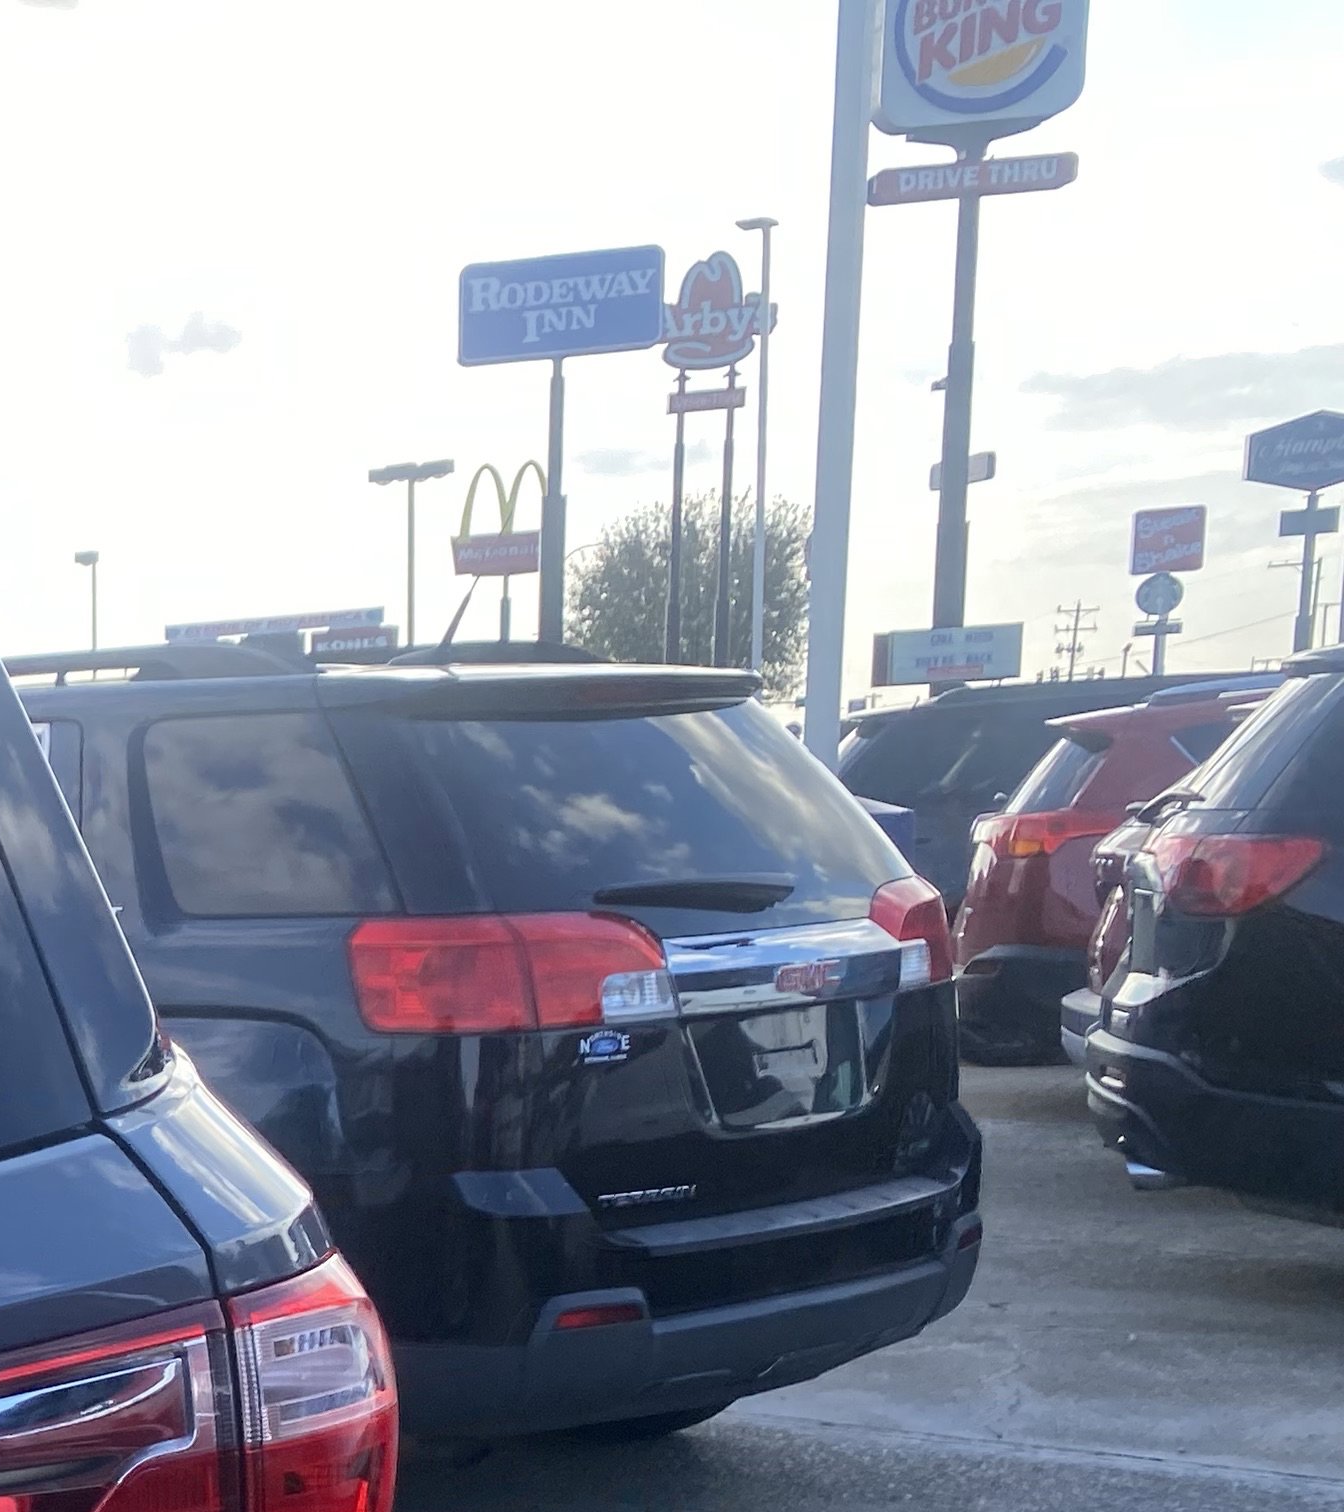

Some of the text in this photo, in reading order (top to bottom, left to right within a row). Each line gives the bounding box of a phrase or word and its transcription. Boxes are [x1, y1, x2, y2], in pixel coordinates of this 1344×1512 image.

[918, 0, 1062, 83] KING
[898, 158, 1059, 195] DRIVE THRU
[468, 268, 657, 312] RODEWAY
[522, 304, 598, 343] INN
